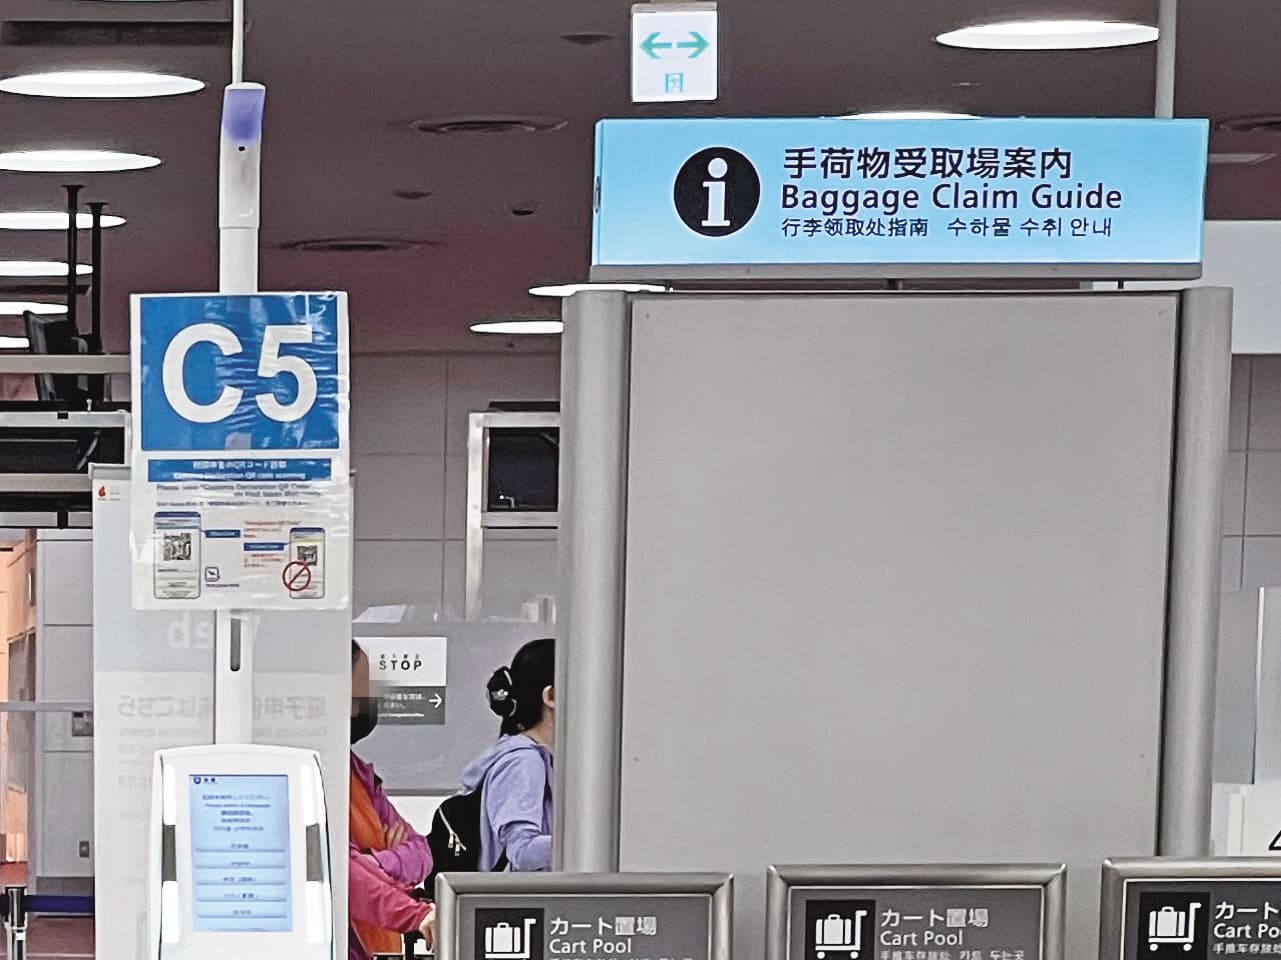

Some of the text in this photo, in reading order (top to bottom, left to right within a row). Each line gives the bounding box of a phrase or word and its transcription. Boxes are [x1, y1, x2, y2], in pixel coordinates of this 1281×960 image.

[783, 146, 1072, 179] 手荷物受取場案内
[781, 182, 1122, 216] Baggage Claim Guide
[781, 217, 929, 237] 行李领取处指南
[947, 216, 1112, 237] 수하물 수취 안내
[162, 322, 318, 423] C5
[379, 660, 422, 671] STOP
[1215, 901, 1279, 920] カート
[880, 929, 964, 946] Cart Pool
[1213, 922, 1281, 939] Cart Po
[549, 937, 632, 954] Cart Pool
